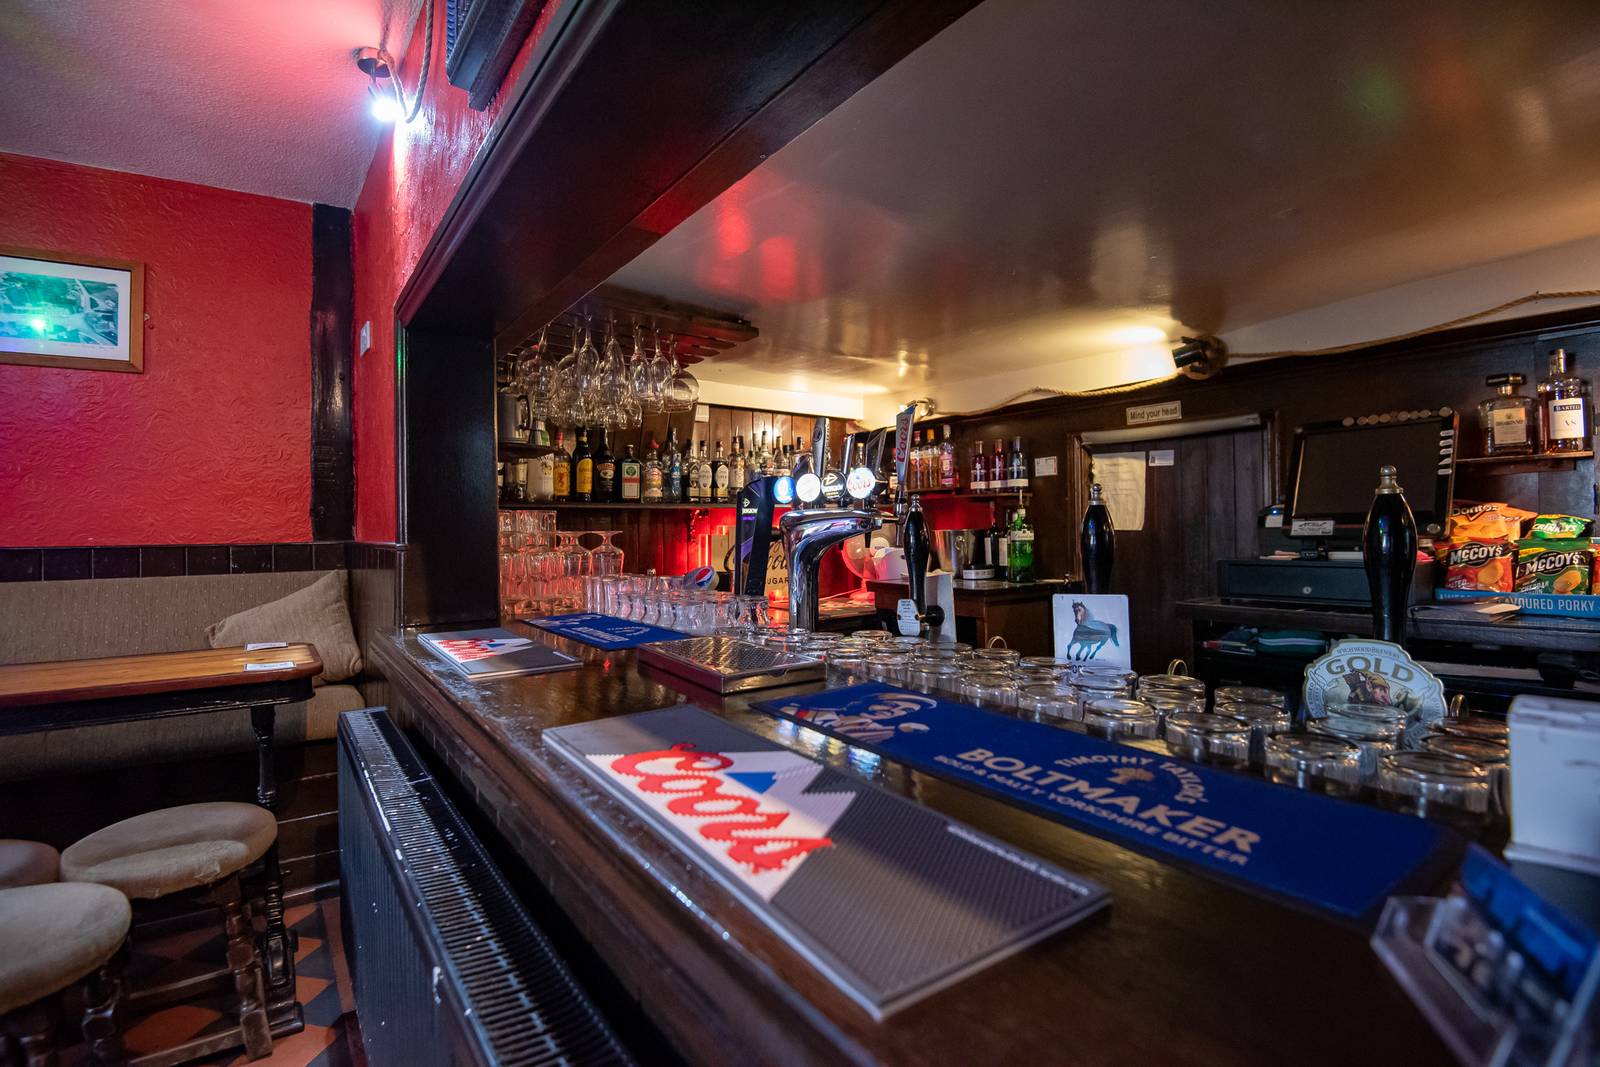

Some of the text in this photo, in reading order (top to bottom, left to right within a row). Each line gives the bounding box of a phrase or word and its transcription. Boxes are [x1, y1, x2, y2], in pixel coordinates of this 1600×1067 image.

[1130, 406, 1178, 421] Mind your head
[767, 577, 790, 585] UGAR
[1558, 600, 1595, 612] PORKY
[1326, 656, 1415, 682] GOLD
[1054, 755, 1154, 768] TIMOTHY
[611, 744, 832, 874] Coors
[956, 748, 1262, 853] BOLTMAKER
[1048, 792, 1161, 835] YORKSHIRE
[1162, 830, 1249, 866] BITTER
